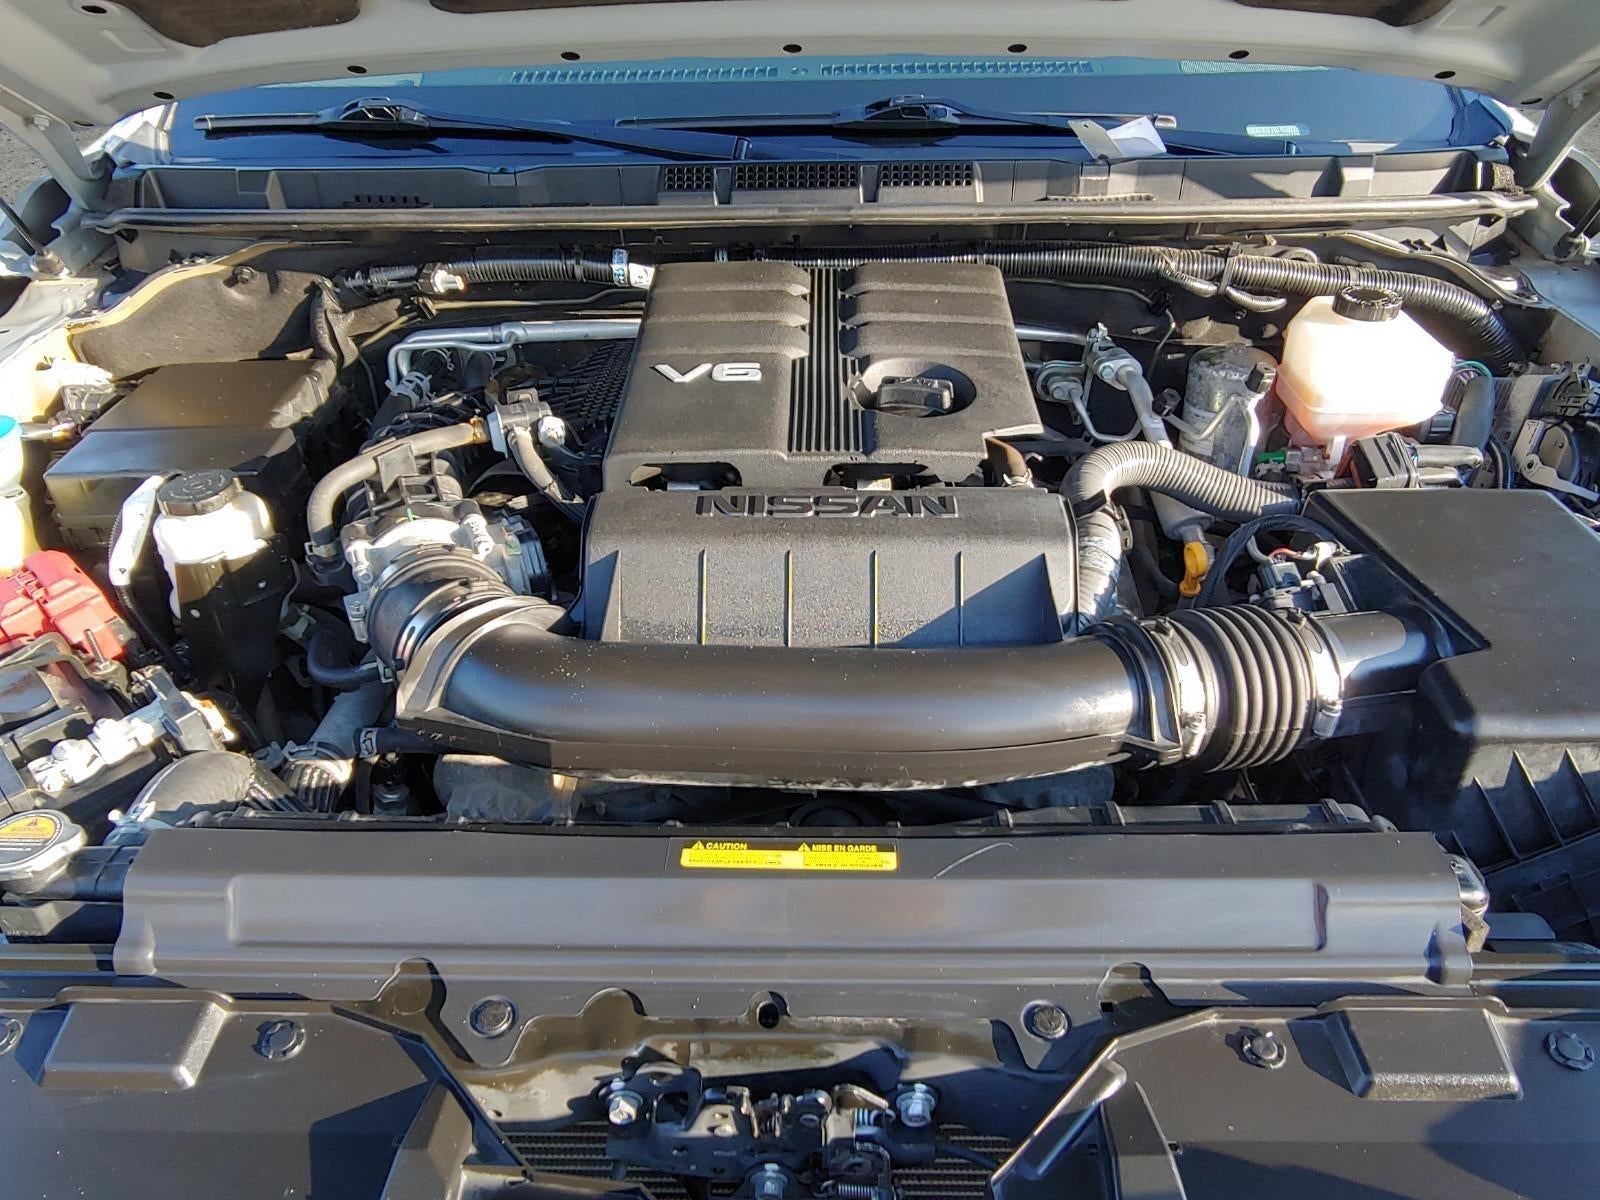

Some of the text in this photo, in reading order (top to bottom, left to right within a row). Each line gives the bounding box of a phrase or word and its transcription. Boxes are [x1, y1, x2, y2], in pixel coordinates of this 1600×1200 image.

[652, 362, 762, 383] V6
[696, 494, 959, 518] NISSAN
[705, 842, 748, 850] CAUTION
[811, 844, 832, 852] MISE
[833, 844, 846, 852] EN
